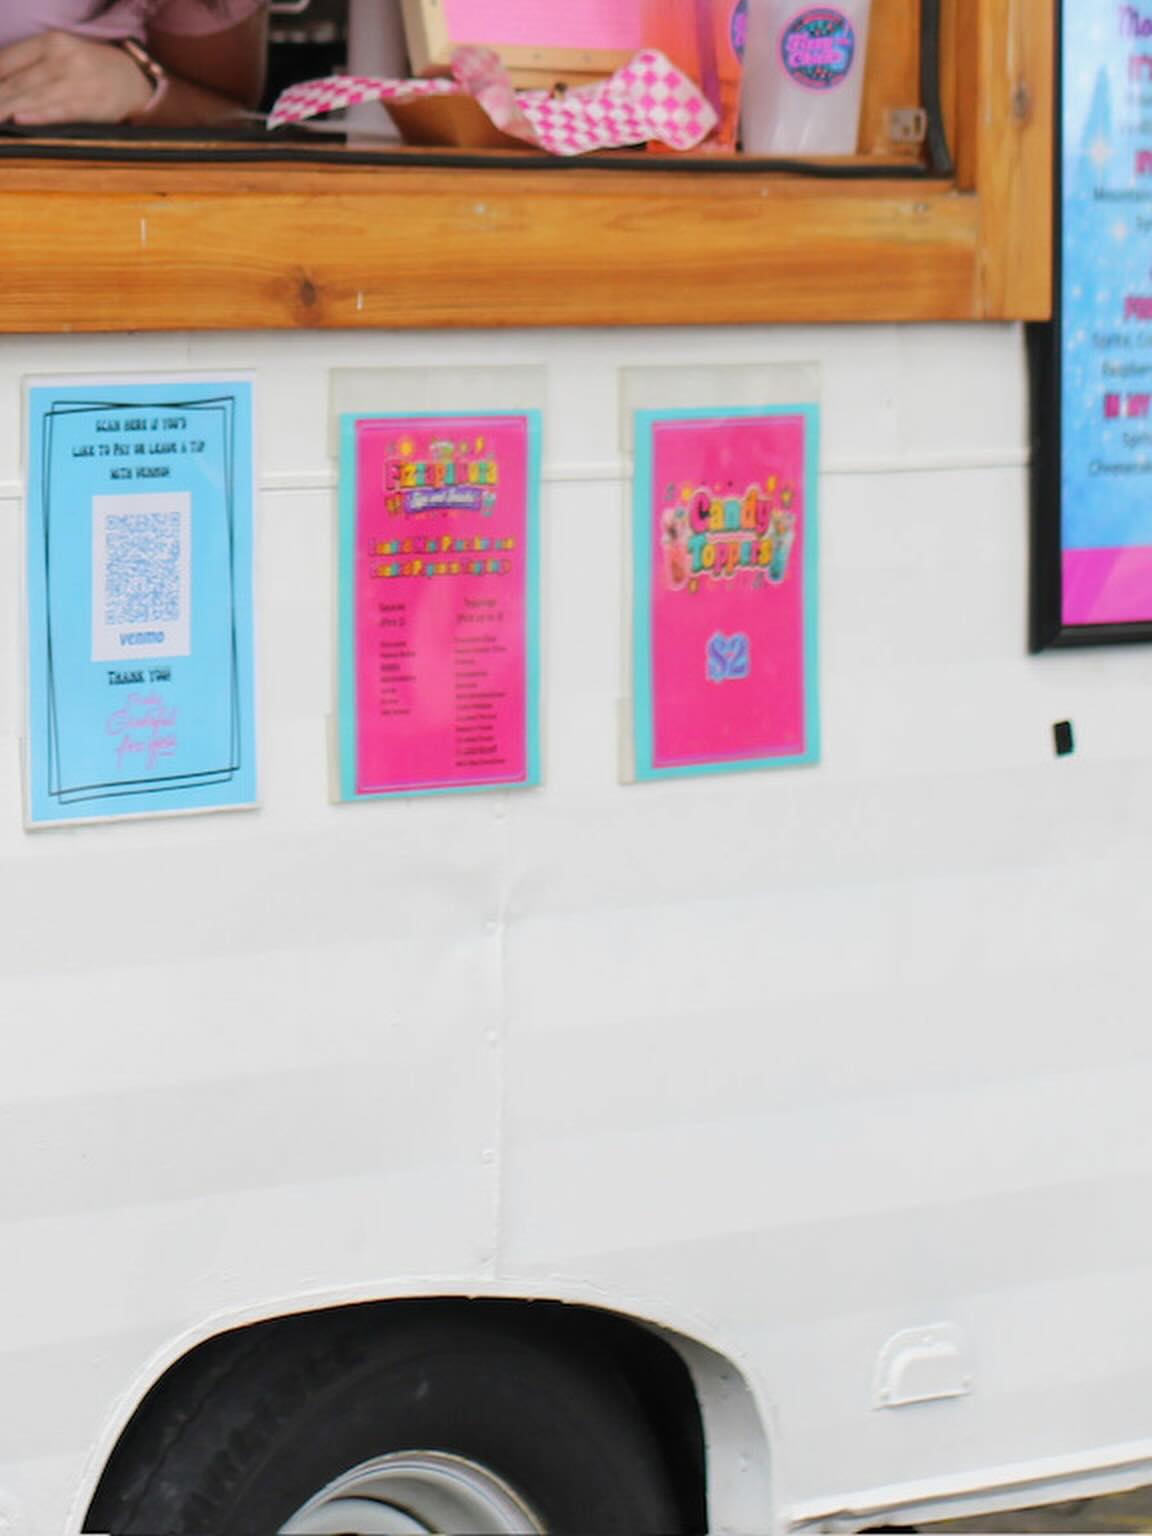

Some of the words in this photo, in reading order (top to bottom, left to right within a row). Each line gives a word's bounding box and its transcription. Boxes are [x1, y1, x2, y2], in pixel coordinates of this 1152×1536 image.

[689, 486, 773, 540] Candy
[687, 531, 773, 578] Toppers
[118, 630, 165, 646] venmo
[708, 634, 750, 683] $2
